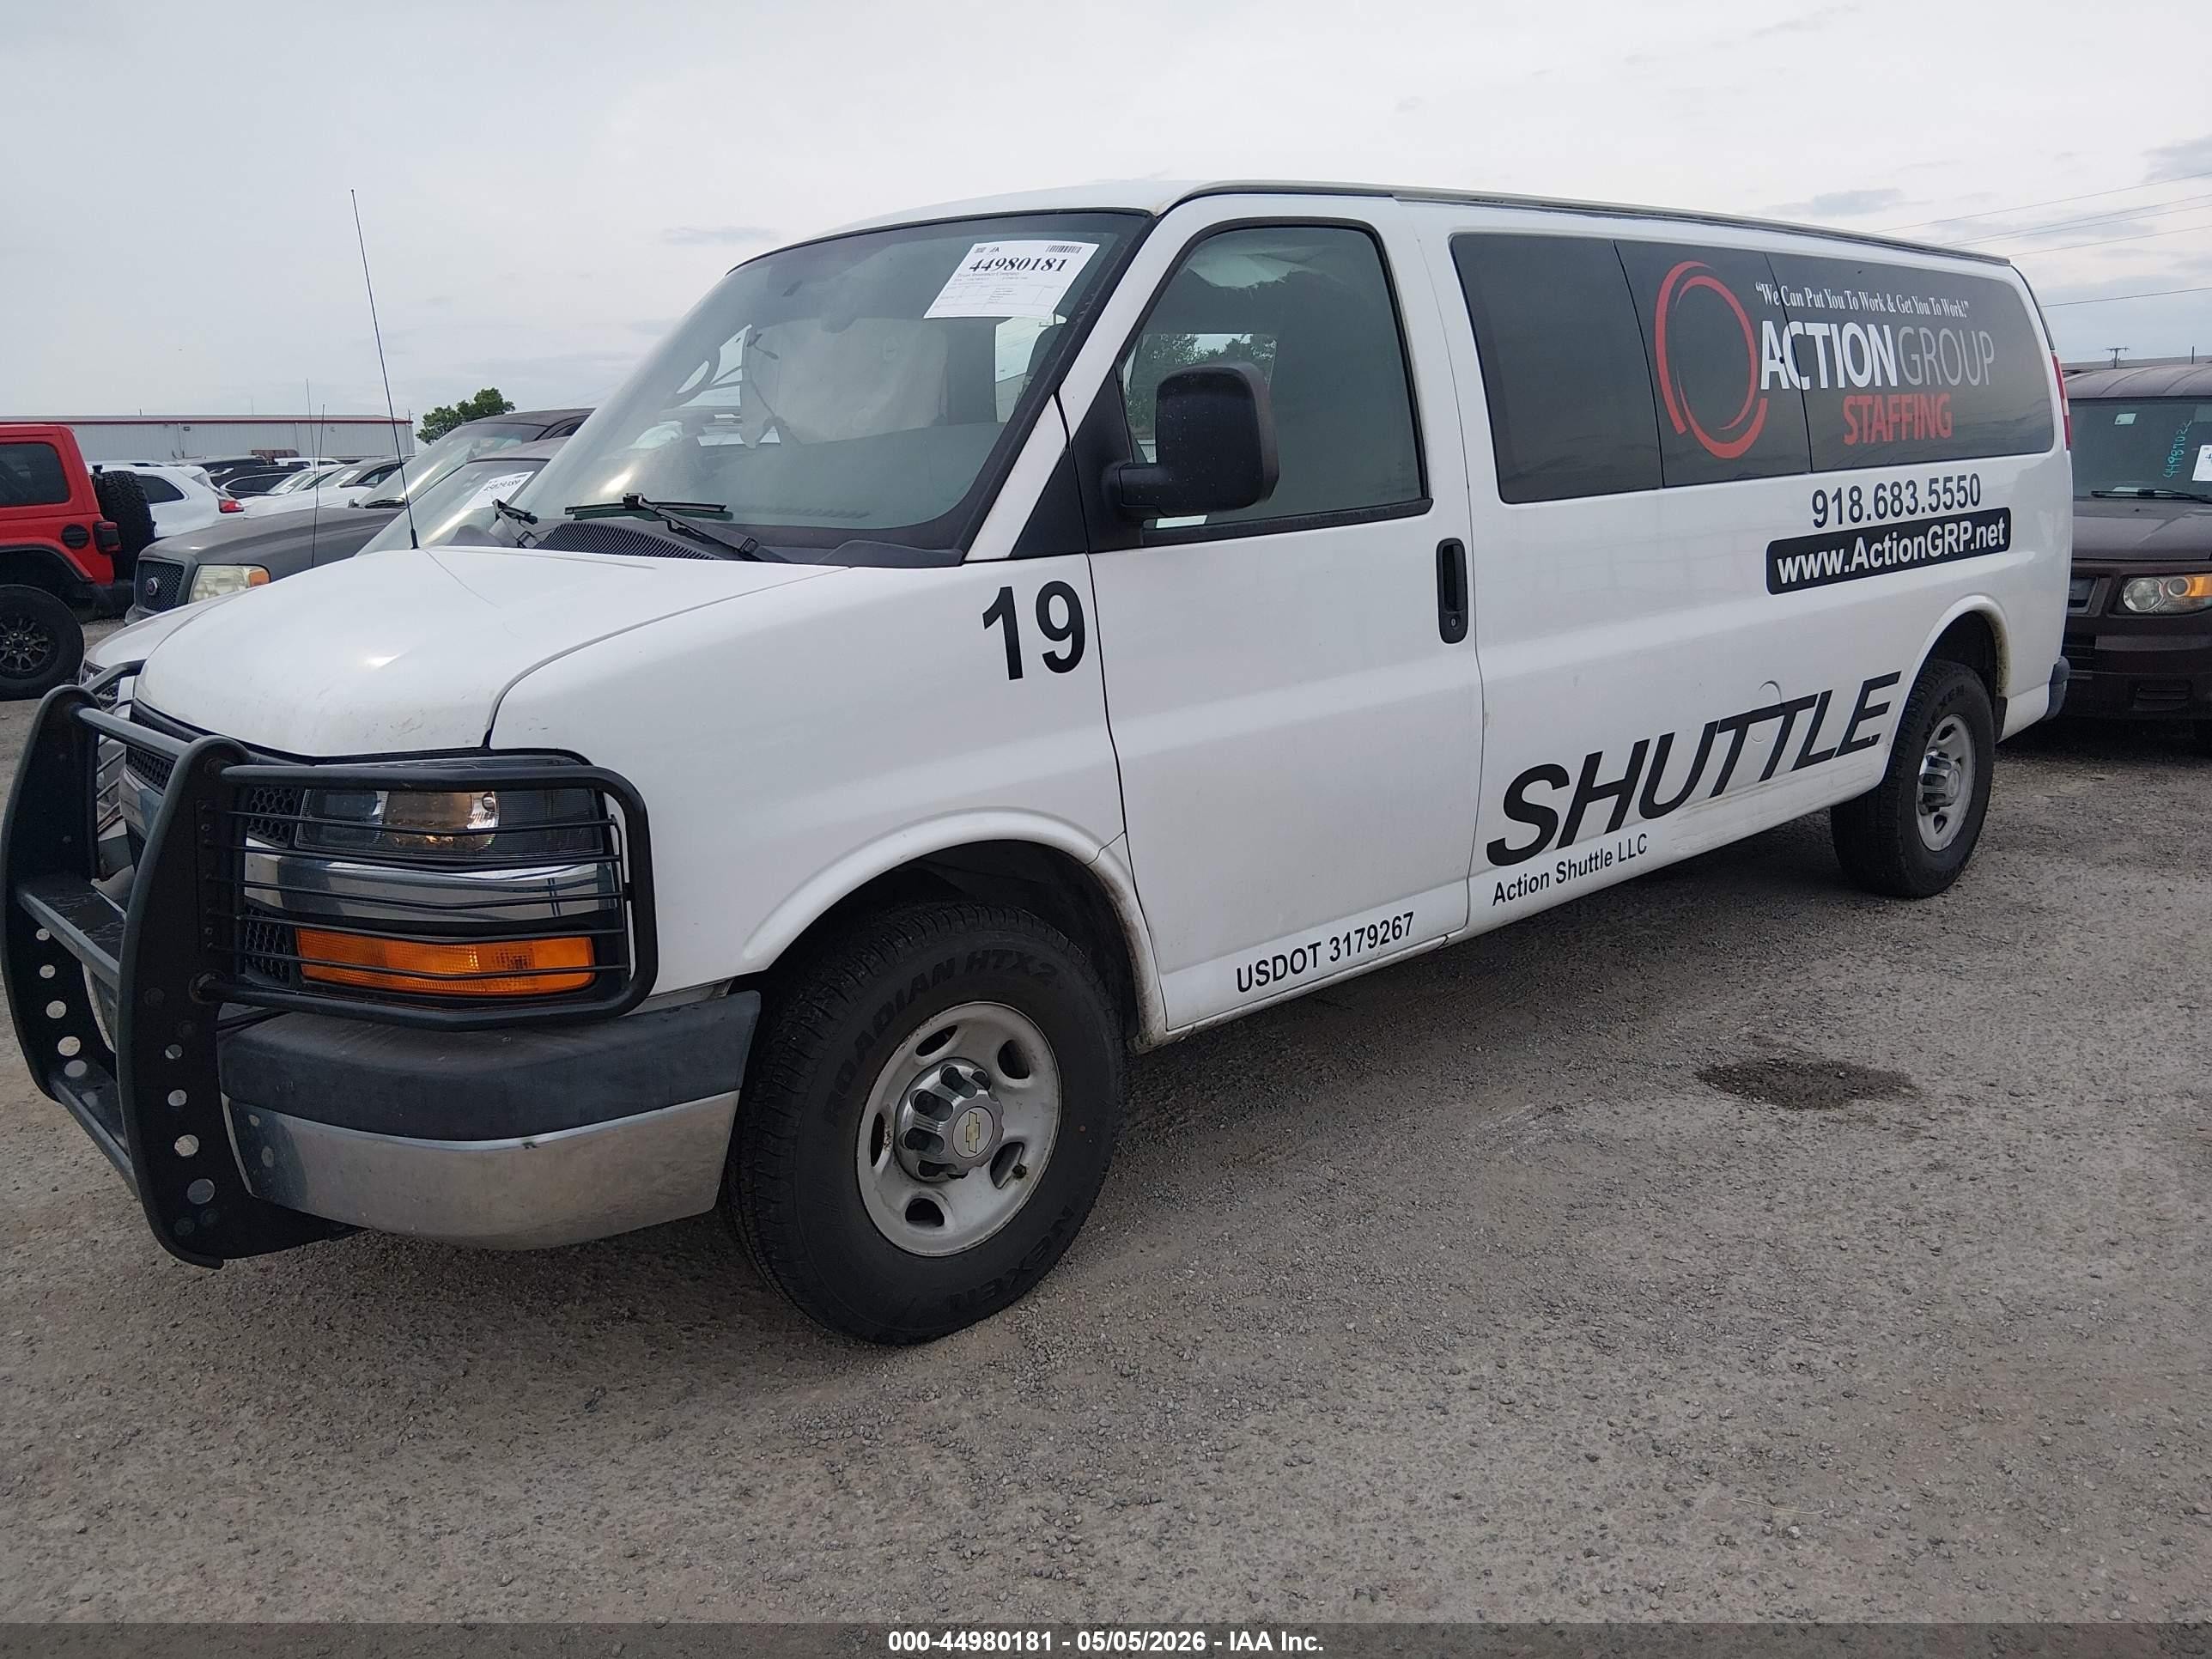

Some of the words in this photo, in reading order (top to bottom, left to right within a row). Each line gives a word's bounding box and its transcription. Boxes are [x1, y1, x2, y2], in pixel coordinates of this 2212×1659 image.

[969, 257, 1069, 272] 44980181
[1780, 285, 1803, 308] Can
[1803, 287, 1826, 309] Put
[1824, 289, 1846, 310] You
[1844, 290, 1859, 311] To
[1857, 291, 1887, 313] Work
[1887, 293, 1896, 313] &
[1896, 294, 1914, 315] Get
[1911, 295, 1931, 316] You
[1929, 297, 1942, 317] To
[1843, 392, 1952, 446] STAFFING
[1812, 473, 1981, 529] 918.683.5550
[1777, 517, 2005, 585] www.ActionGRP.net
[982, 580, 1085, 680] 19
[1486, 672, 1901, 866] SHUTTLE
[1492, 872, 1550, 906] Action
[1556, 848, 1613, 884] Shuttle
[1618, 833, 1648, 863] LLC
[1237, 941, 1322, 993] USDOT
[1329, 911, 1414, 962] 3179267
